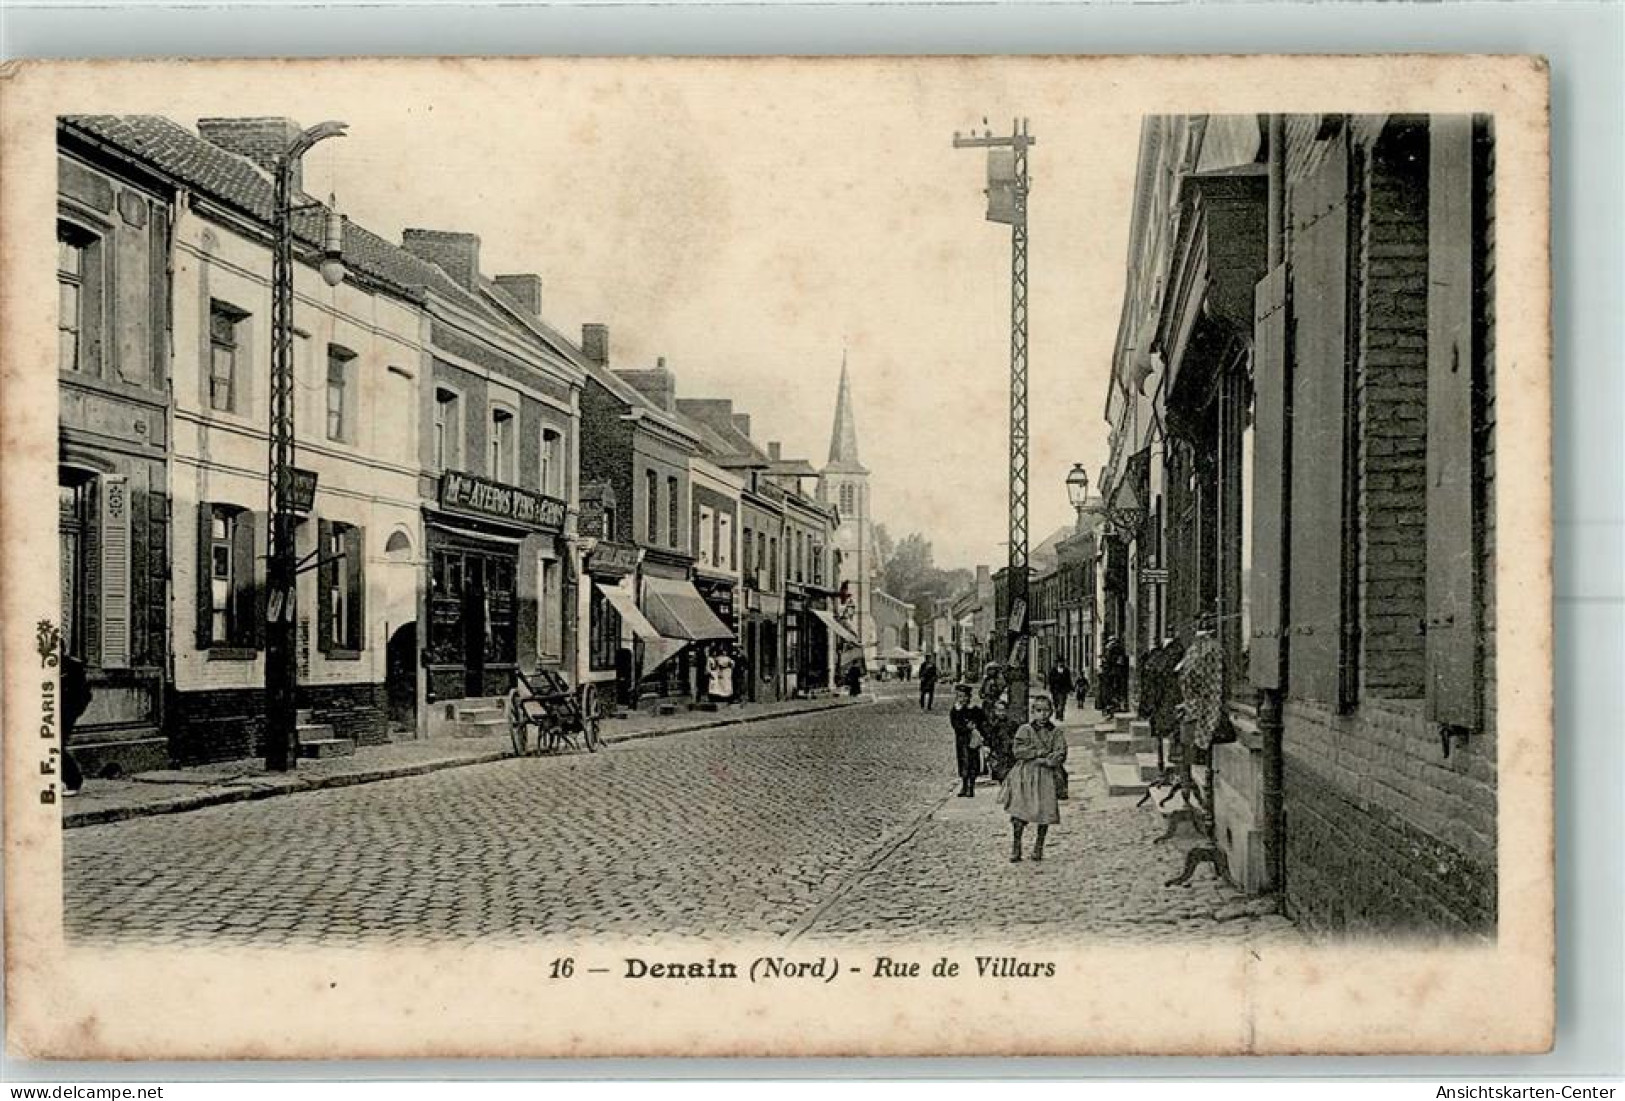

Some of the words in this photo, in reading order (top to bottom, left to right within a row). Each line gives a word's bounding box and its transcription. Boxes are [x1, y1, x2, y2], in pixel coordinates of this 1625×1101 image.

[40, 747, 59, 776] F.,
[40, 783, 56, 805] B.
[550, 957, 575, 979] 16
[624, 957, 737, 979] Denain
[749, 957, 839, 983] (Nord)
[873, 957, 920, 977] Rue
[932, 957, 959, 977] de
[975, 957, 1055, 977] Villars
